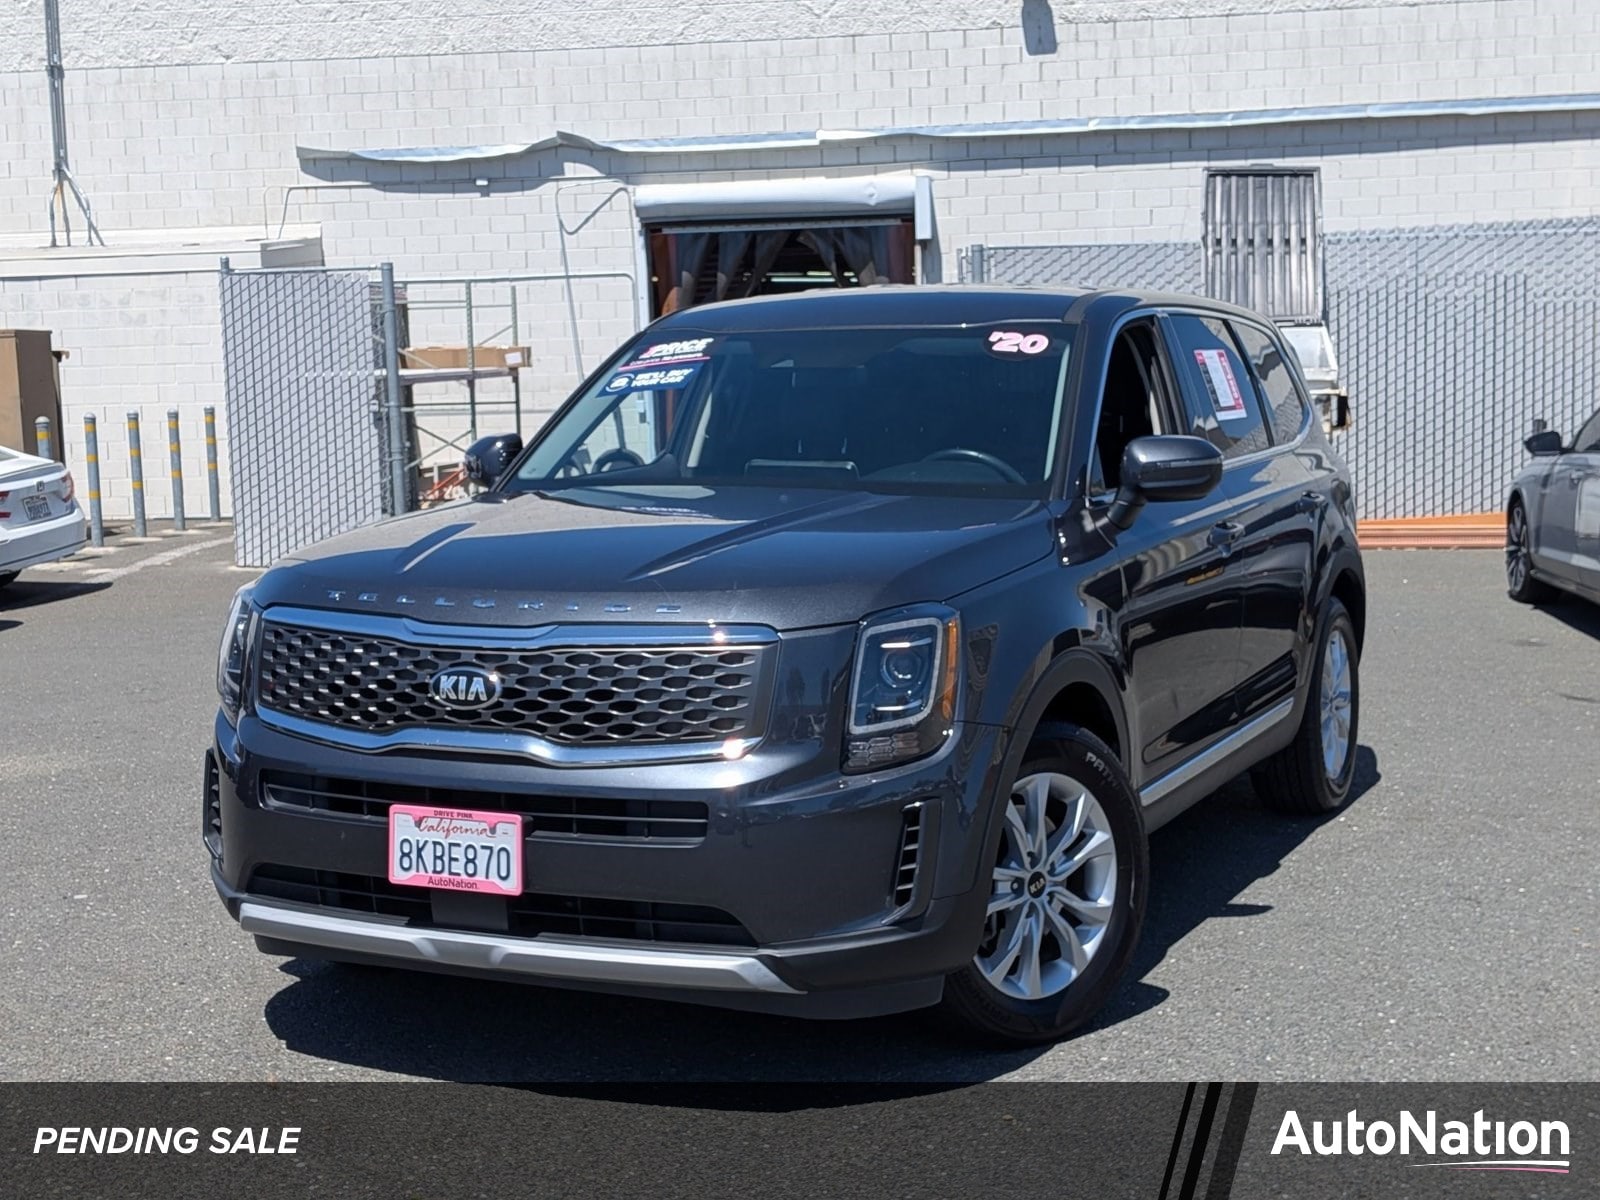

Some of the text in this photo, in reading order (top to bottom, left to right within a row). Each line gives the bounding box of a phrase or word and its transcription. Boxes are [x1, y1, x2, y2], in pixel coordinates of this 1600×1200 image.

[988, 331, 1049, 354] '20
[438, 674, 488, 701] KIA
[433, 809, 474, 819] DRIVE PINK
[417, 816, 497, 839] California
[399, 838, 511, 882] 8KBE870
[427, 876, 479, 890] AutoNation
